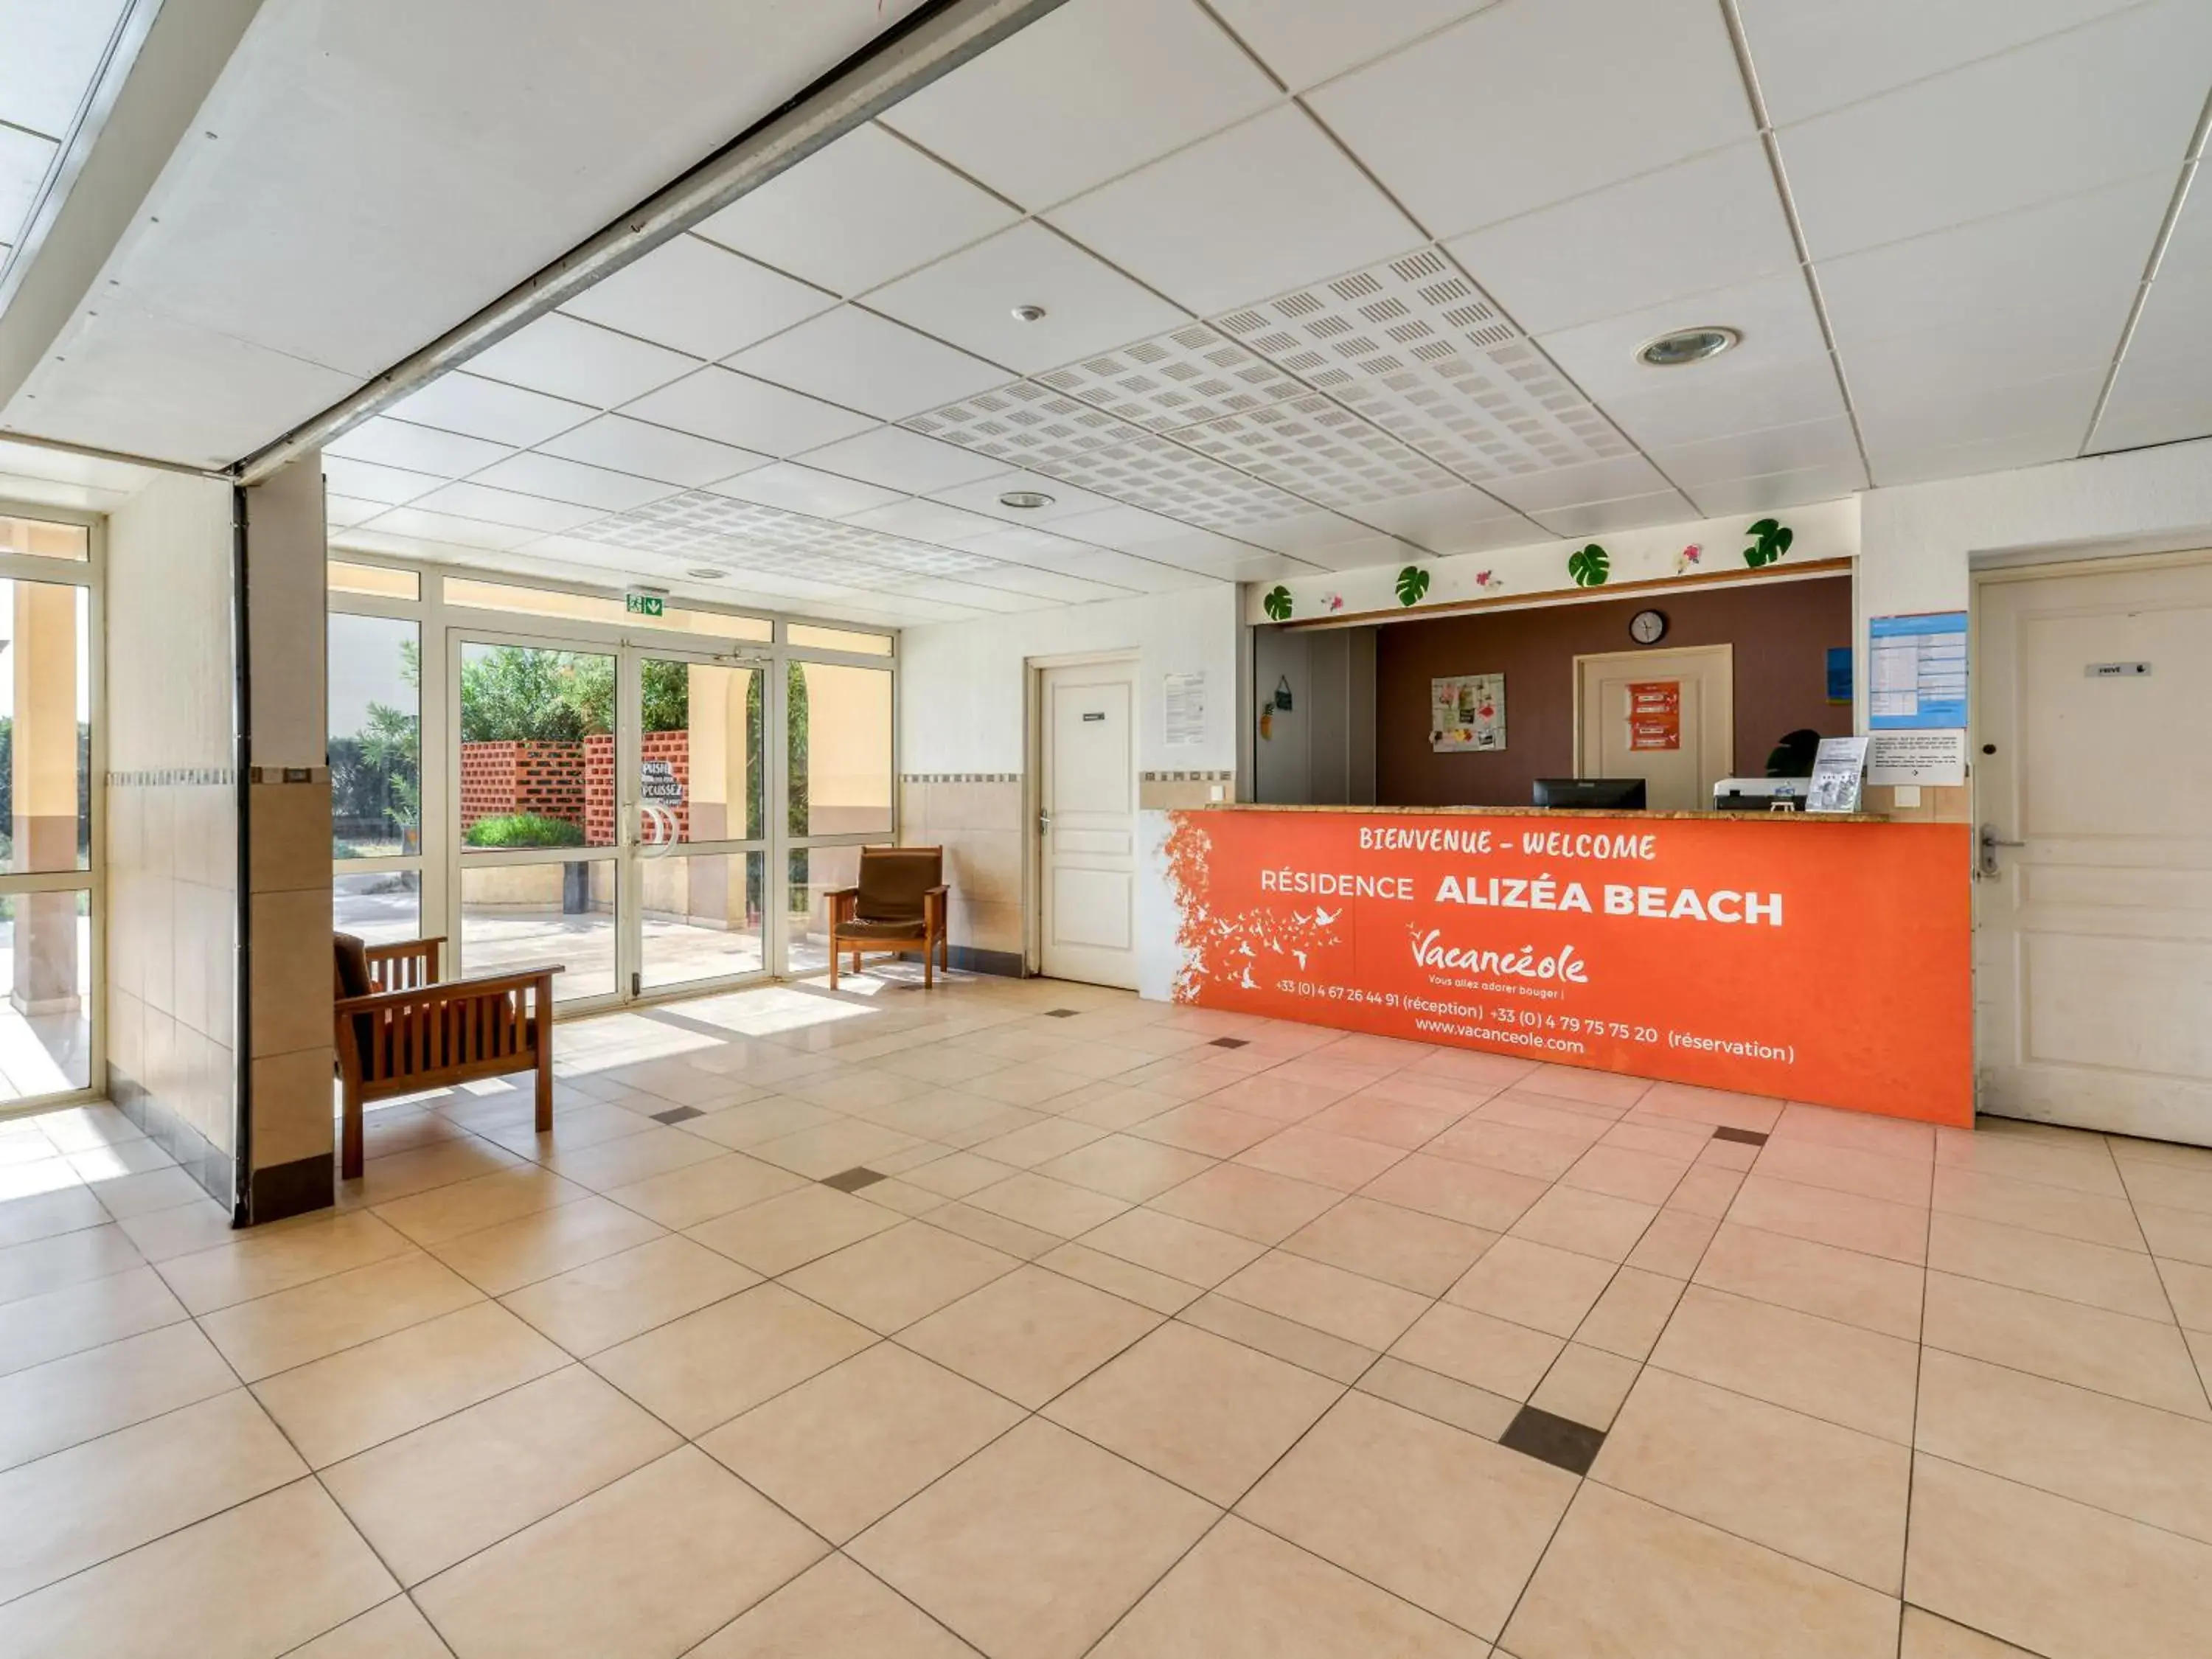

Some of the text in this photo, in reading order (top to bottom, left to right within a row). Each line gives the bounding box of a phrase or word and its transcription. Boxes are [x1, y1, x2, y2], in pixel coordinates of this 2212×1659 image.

[1360, 827, 1492, 853] BIENVENUE
[1523, 831, 1657, 860] WELCOME
[1261, 866, 1783, 926] RÉSIDENCE ALIZÉA BEACH
[1411, 929, 1589, 983] Vacancéole
[1428, 974, 1452, 986] Vous
[1455, 977, 1478, 989] allez
[1481, 981, 1517, 993] adorer
[1519, 986, 1558, 1000] bouger
[1276, 979, 1795, 1064] +33 (0) 4 67 26 44 91 (réception) +33 (0) 4 79 75 75 20 (réservation)
[1415, 1018, 1585, 1054] www.vacanceole.com
